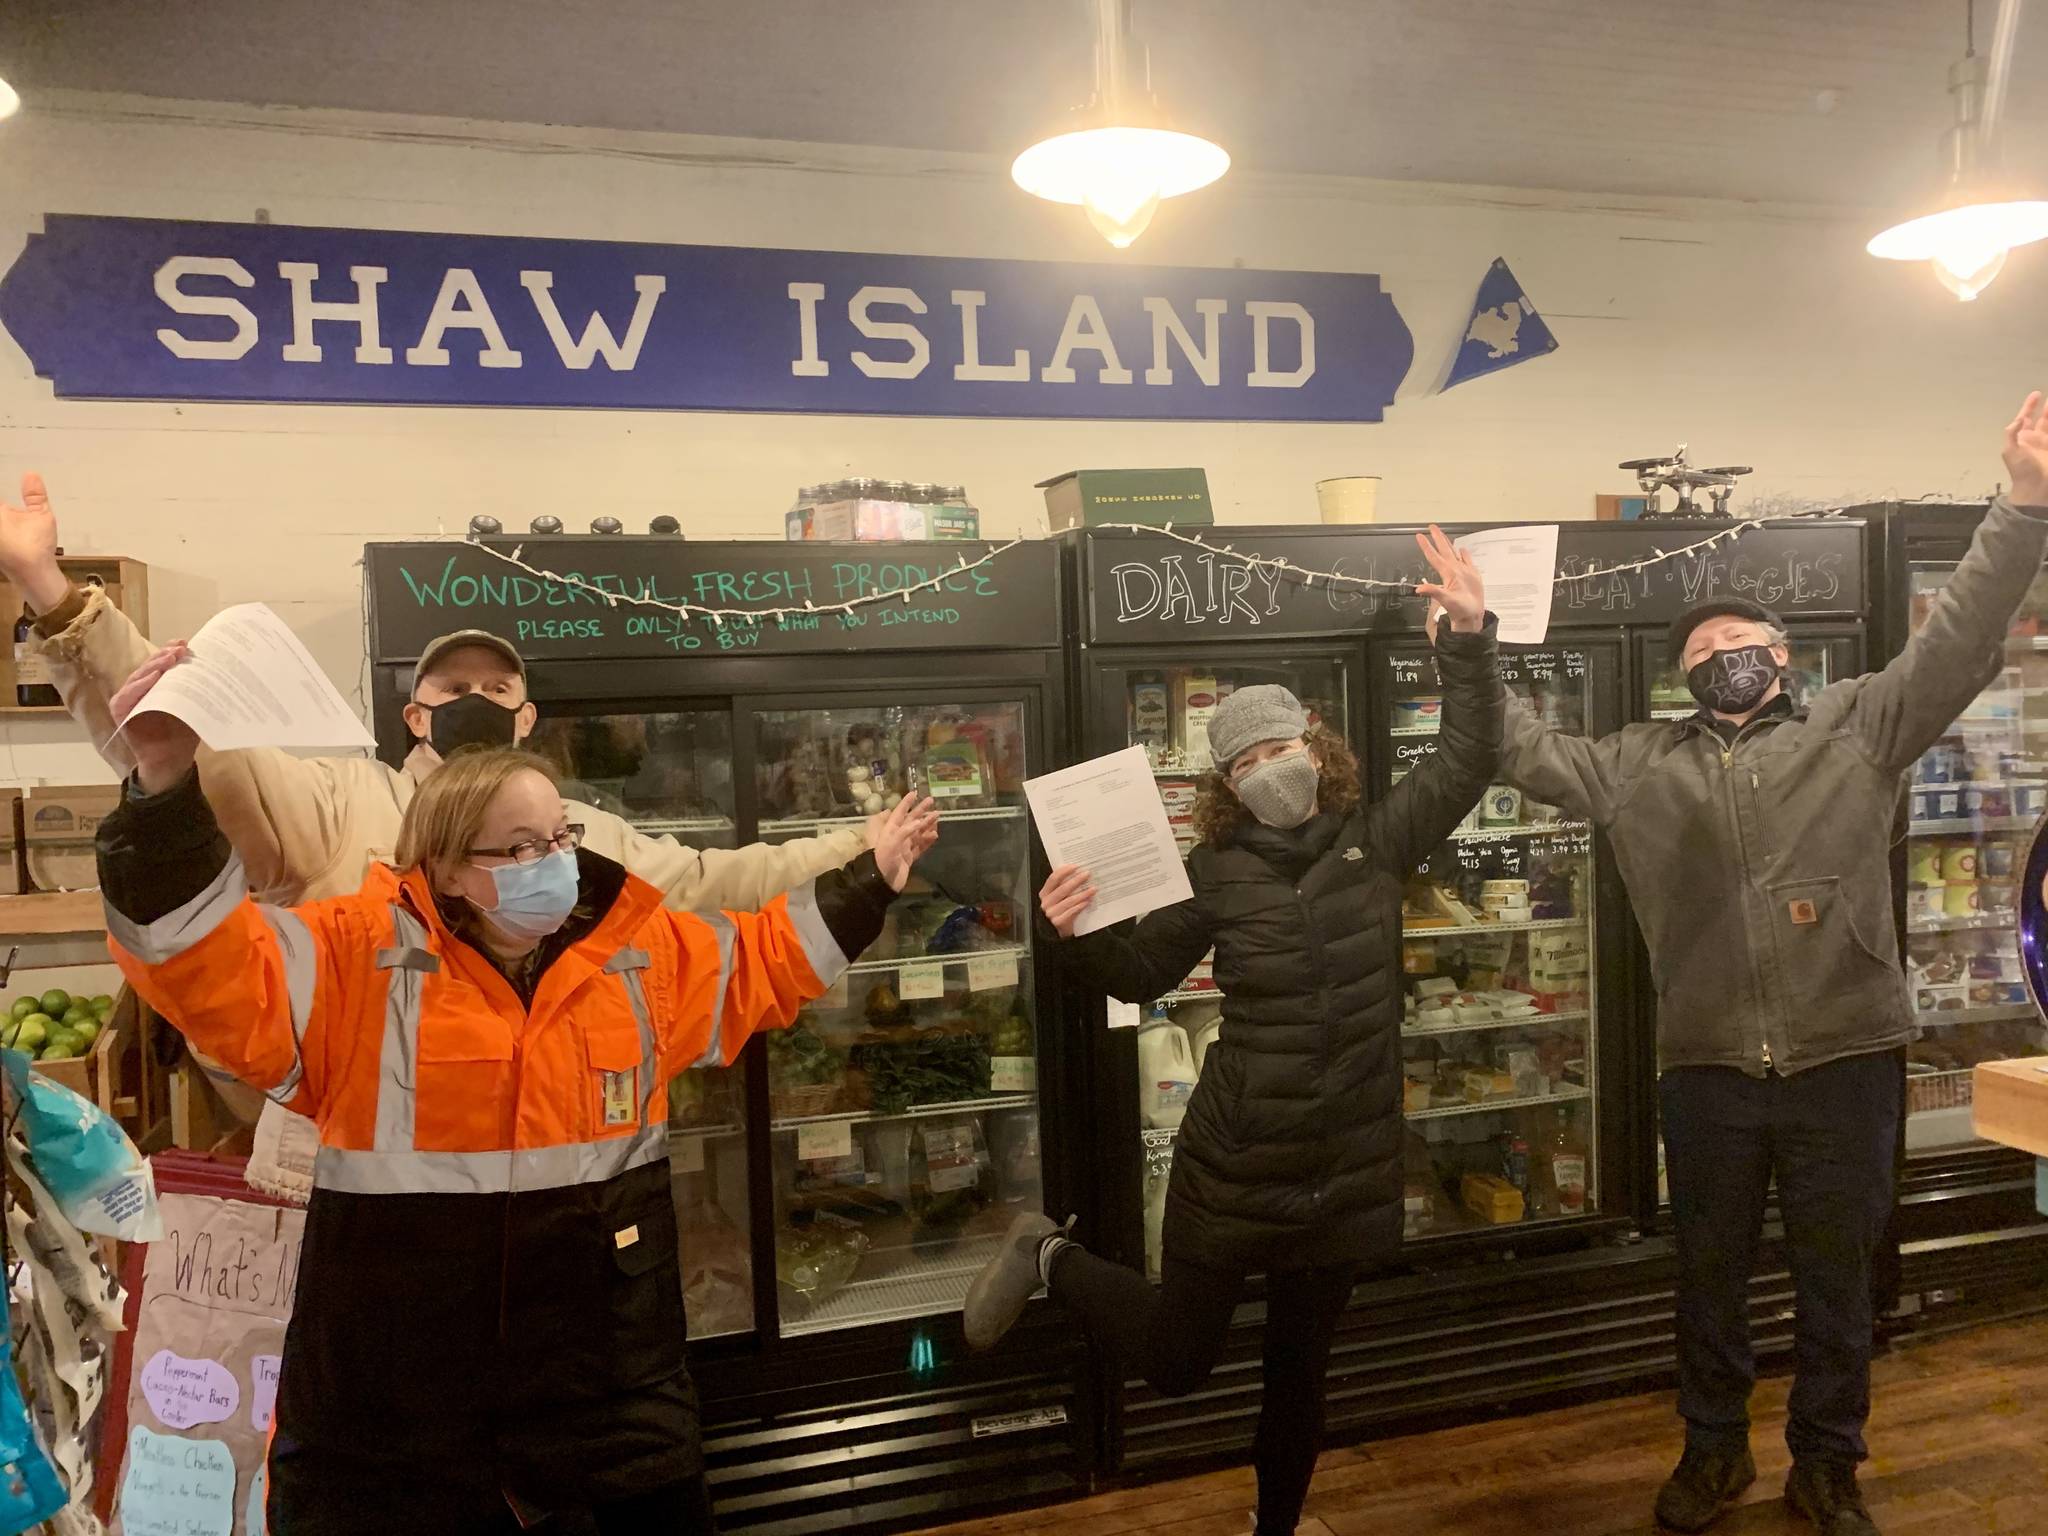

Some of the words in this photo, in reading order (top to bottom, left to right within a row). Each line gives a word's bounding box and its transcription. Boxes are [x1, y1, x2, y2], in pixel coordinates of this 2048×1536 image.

[153, 255, 666, 371] SHAW
[788, 281, 1316, 388] ISLAND
[692, 567, 812, 602] FRESH
[832, 560, 999, 599] PRODUCE
[1110, 553, 1288, 624] DAIRY
[517, 620, 604, 641] PLEASE
[836, 613, 868, 628] YOU
[880, 608, 960, 626] INTEND
[666, 636, 701, 650] TO
[716, 631, 760, 650] BUY
[1144, 1131, 1171, 1147] Good
[170, 1230, 263, 1302] What's
